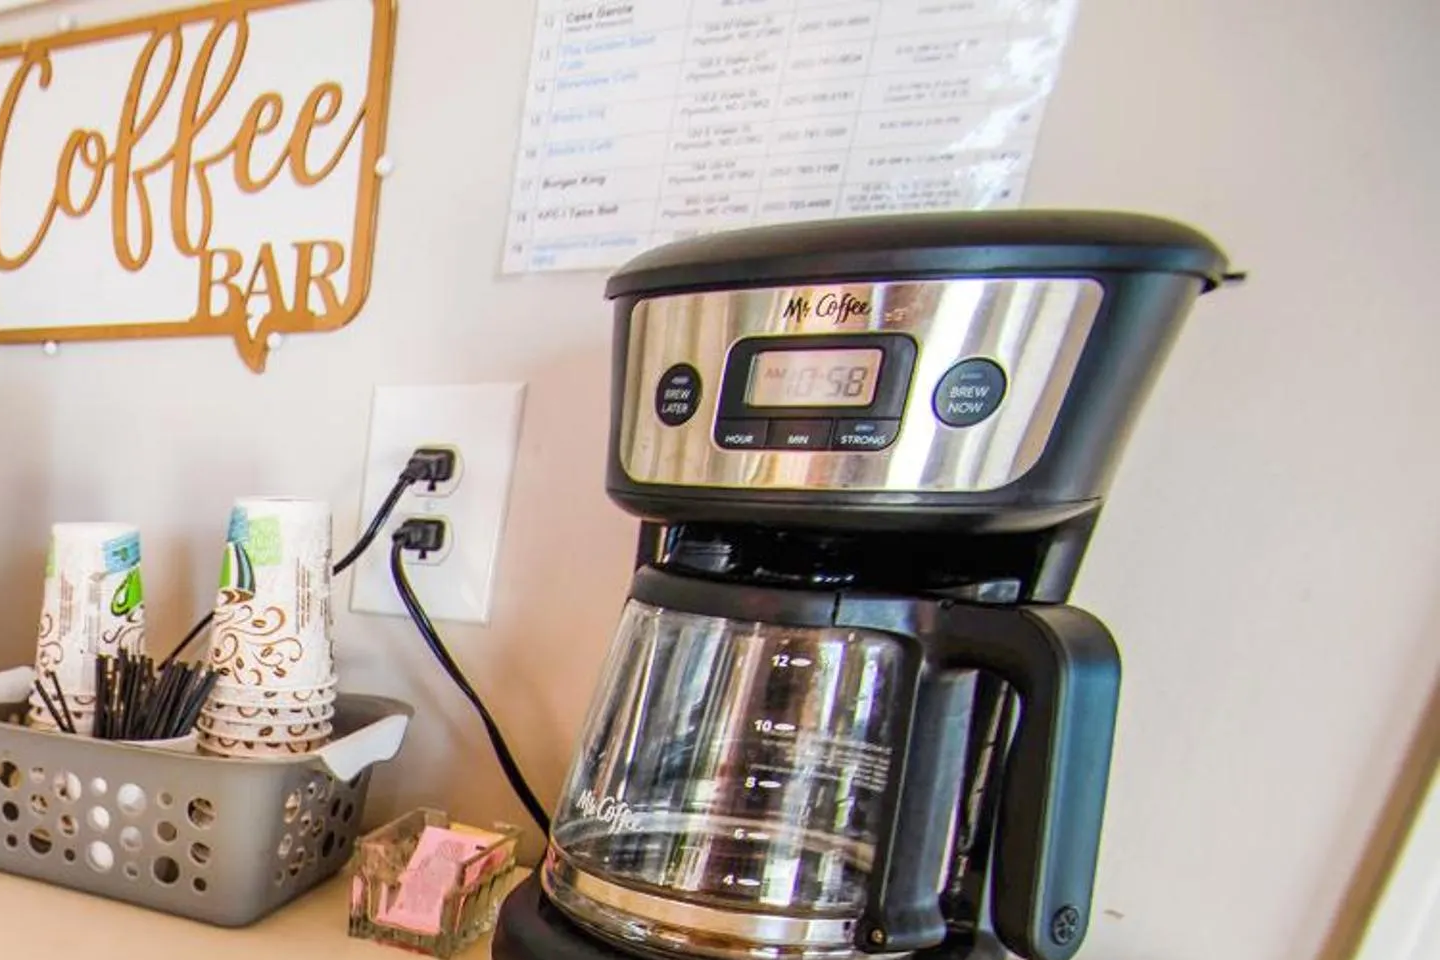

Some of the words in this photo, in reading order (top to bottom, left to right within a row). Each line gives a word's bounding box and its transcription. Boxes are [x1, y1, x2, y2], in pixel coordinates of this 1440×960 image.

[197, 240, 347, 318] BAR
[816, 293, 872, 325] Coffee
[664, 388, 692, 400] BREW
[950, 385, 990, 399] BREW
[661, 401, 689, 415] LATER
[945, 402, 984, 414] NOW
[724, 434, 755, 445] HOUR
[787, 434, 810, 445] MIN
[840, 434, 887, 445] STRONG
[772, 654, 789, 668] 12
[754, 719, 772, 732] 10
[745, 776, 756, 789] 8
